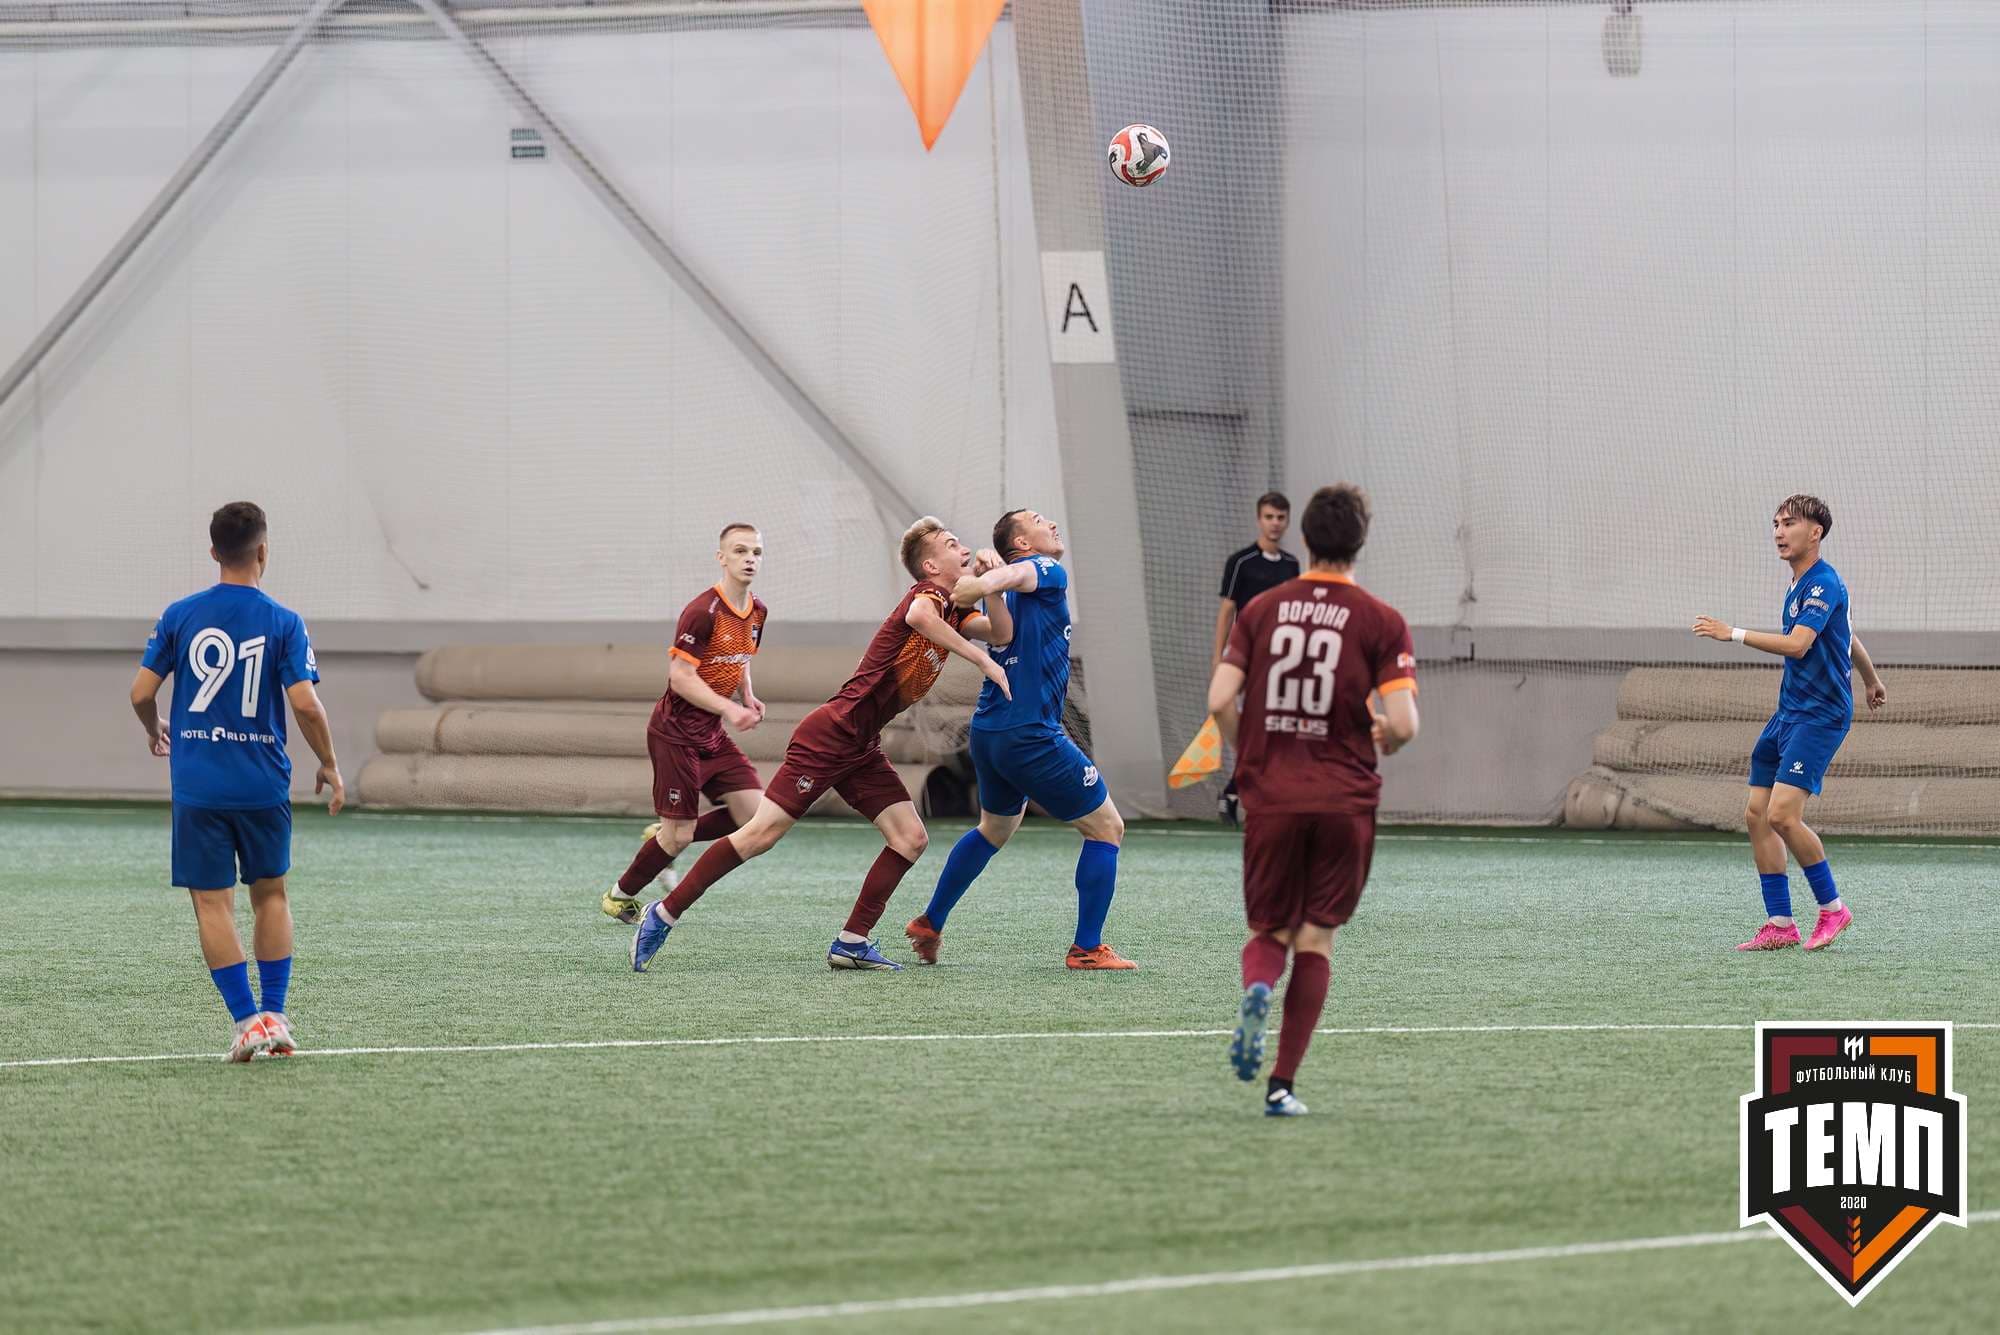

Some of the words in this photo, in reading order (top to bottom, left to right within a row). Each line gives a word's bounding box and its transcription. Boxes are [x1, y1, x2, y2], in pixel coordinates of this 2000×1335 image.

[1061, 282, 1098, 333] A
[1278, 600, 1350, 631] ВОРОНА
[188, 627, 266, 718] 91
[1266, 625, 1342, 716] 23
[181, 729, 209, 740] HOTEL
